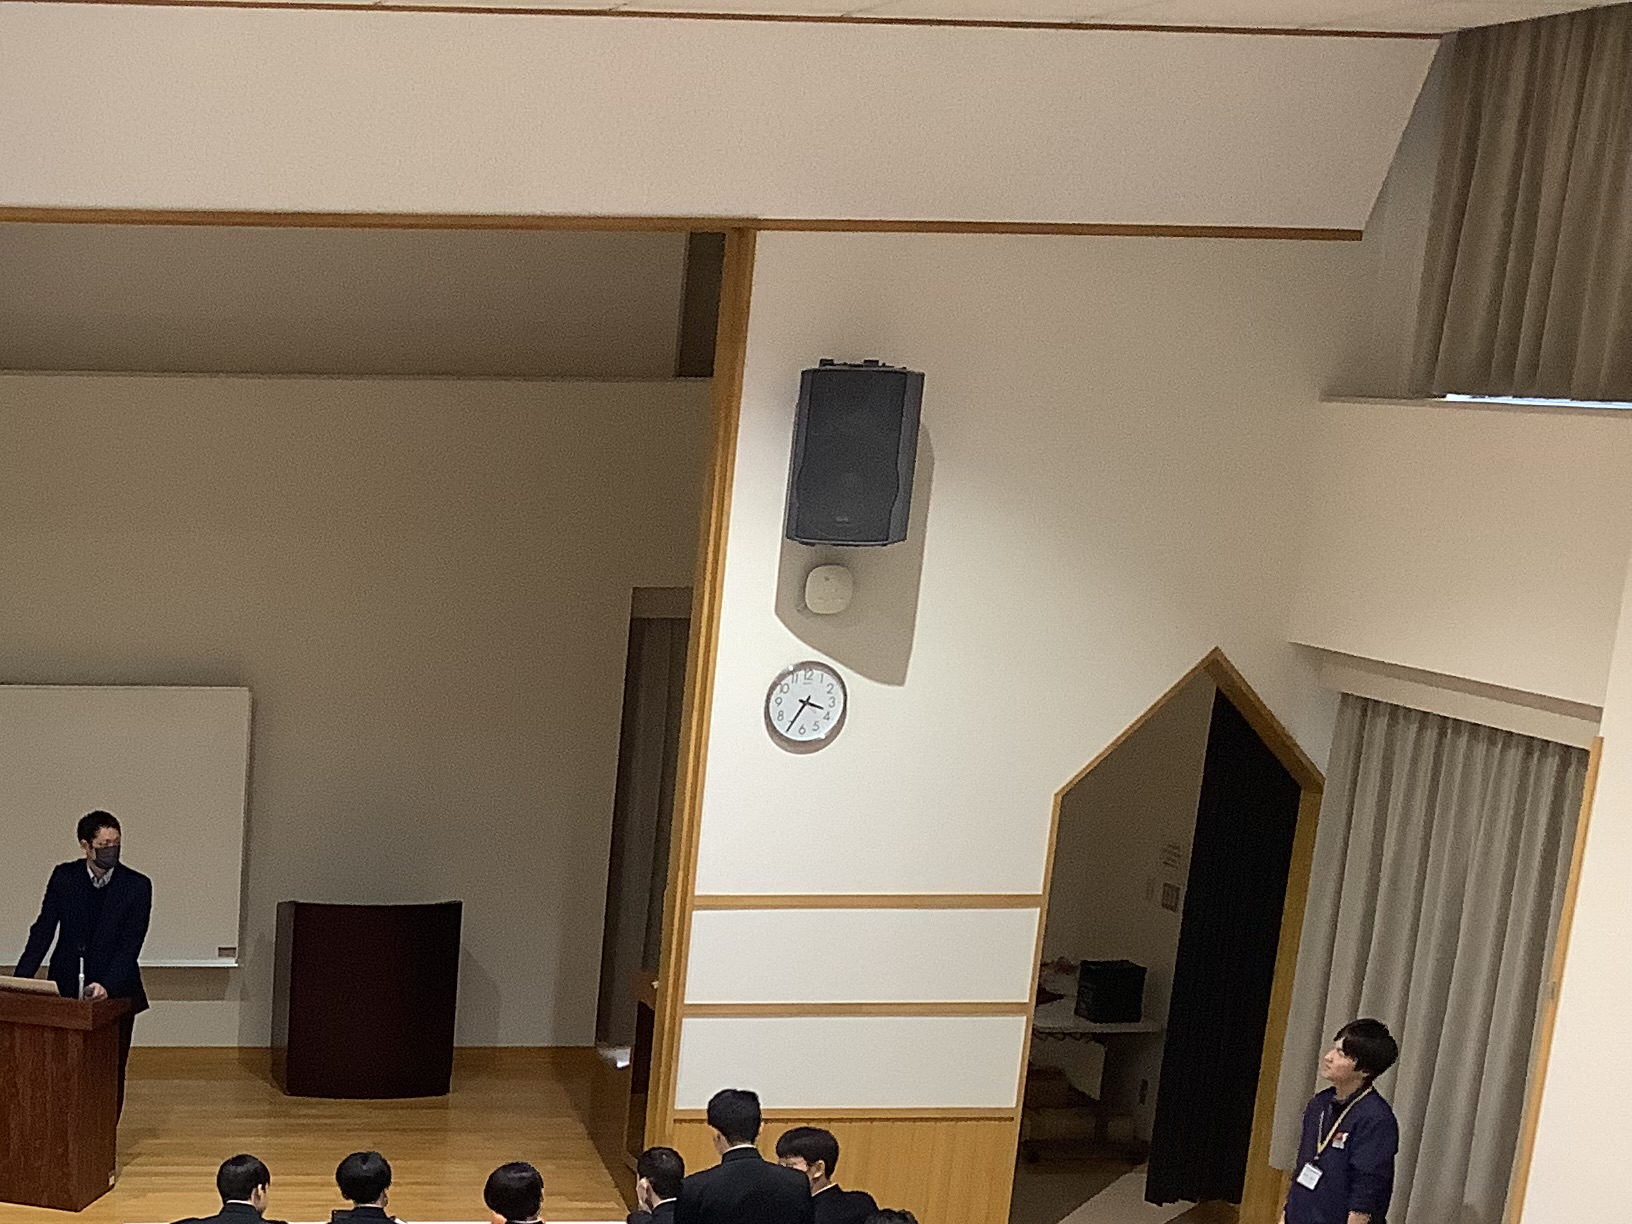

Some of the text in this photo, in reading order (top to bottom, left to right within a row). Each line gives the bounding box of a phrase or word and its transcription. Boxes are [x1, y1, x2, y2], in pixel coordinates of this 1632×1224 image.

[803, 668, 814, 680] 12
[779, 683, 790, 694] 10
[826, 683, 834, 694] 2
[774, 696, 783, 707] 9
[828, 696, 836, 708] 3
[776, 709, 784, 721] 8
[823, 711, 830, 721] 4
[798, 724, 806, 735] 6
[812, 720, 820, 731] 5
